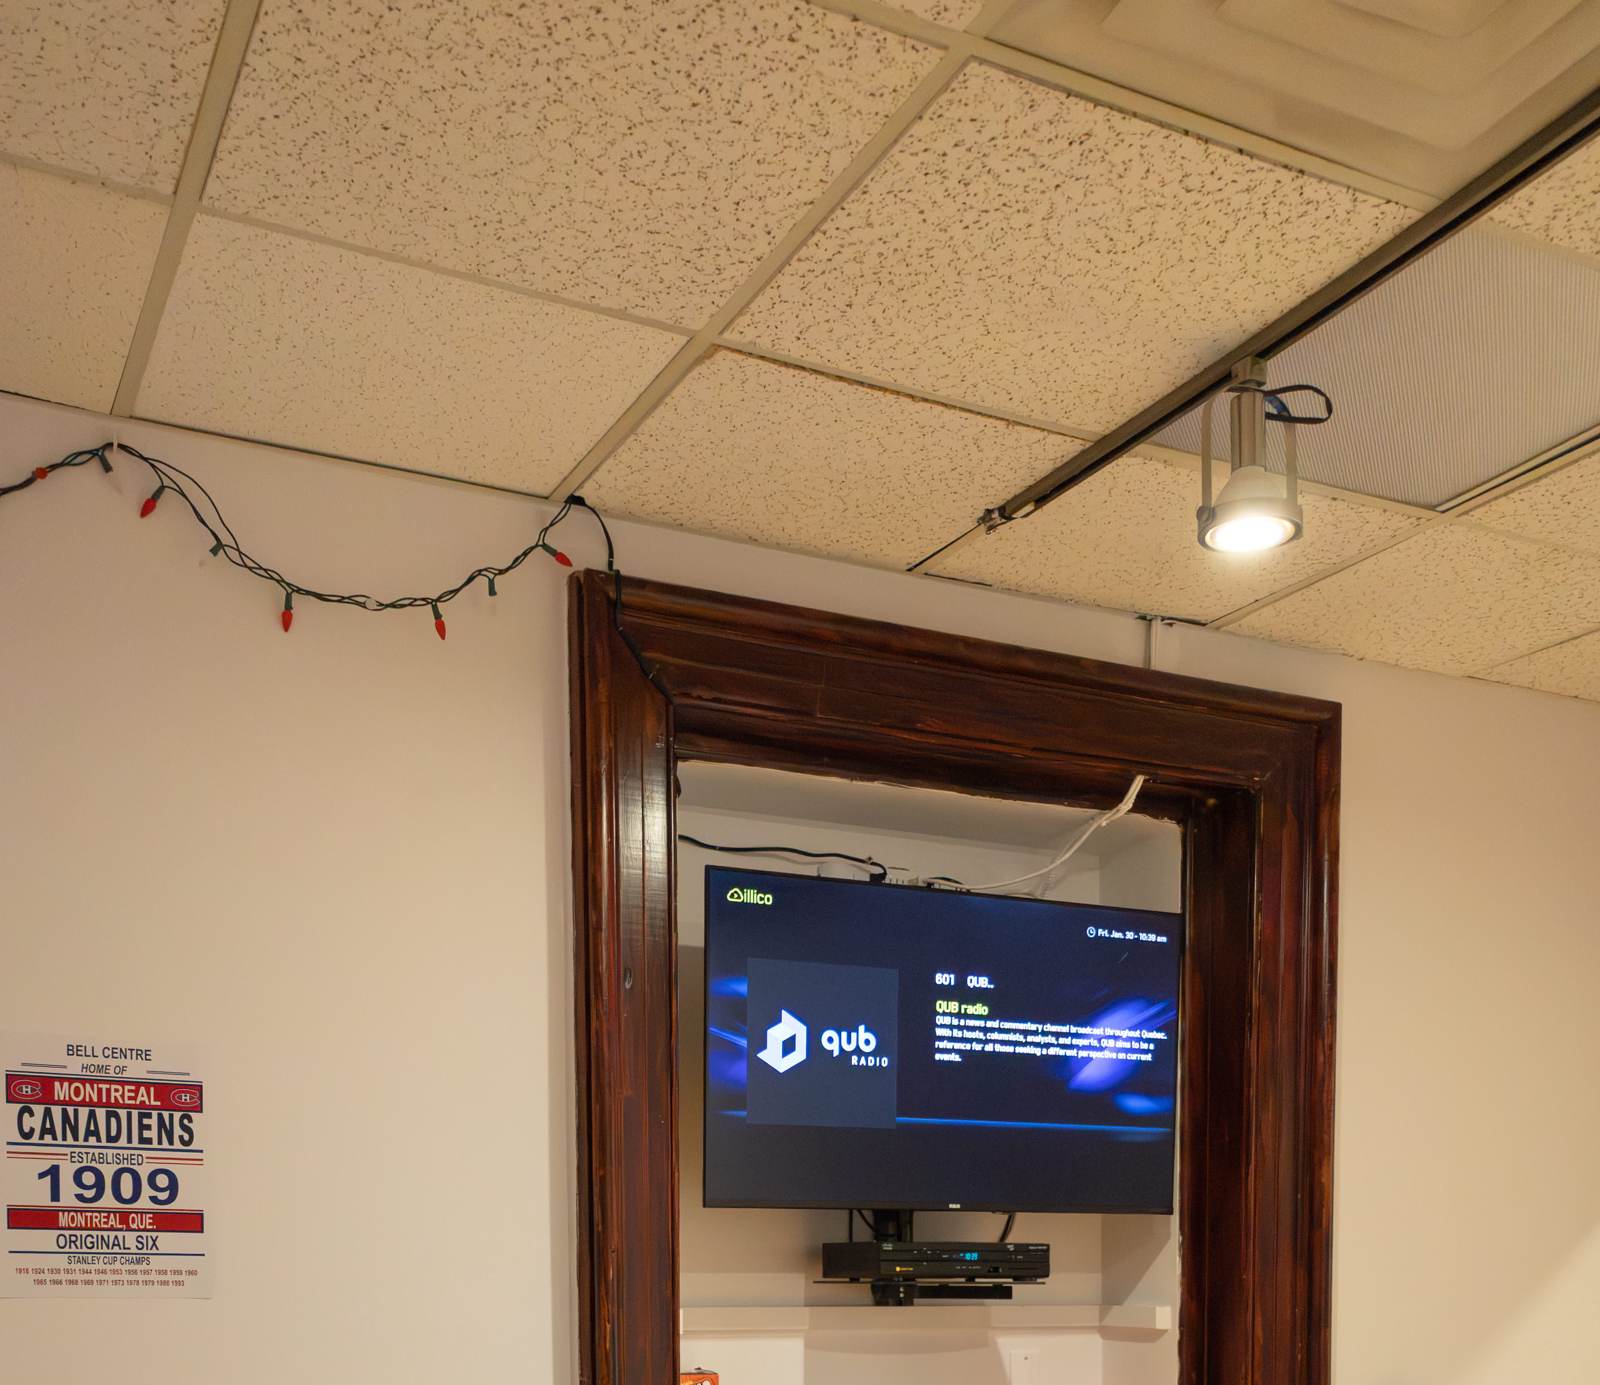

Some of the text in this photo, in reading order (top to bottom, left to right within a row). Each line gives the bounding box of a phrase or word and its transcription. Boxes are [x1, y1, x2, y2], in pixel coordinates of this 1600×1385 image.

[743, 889, 773, 905] illico
[1110, 930, 1124, 939] Jan.
[1125, 931, 1134, 940] 30
[935, 973, 955, 986] 601
[935, 1000, 989, 1015] QUB radio
[935, 1015, 951, 1026] QUB
[951, 1017, 959, 1026] is
[965, 1018, 985, 1028] news
[985, 1019, 999, 1028] and
[999, 1021, 1043, 1033] commentary
[1043, 1023, 1069, 1033] channel
[1070, 1025, 1104, 1036] broadcast
[1104, 1026, 1140, 1038] throughout
[820, 1023, 877, 1058] qub
[935, 1027, 952, 1037] With
[952, 1028, 963, 1038] its
[963, 1029, 986, 1040] hosts,
[986, 1031, 1026, 1042] columnists,
[1026, 1033, 1057, 1045] analysts,
[1058, 1036, 1071, 1045] and
[1071, 1037, 1100, 1047] experts,
[1100, 1038, 1116, 1048] QUB
[1115, 1040, 1131, 1049] aims
[1131, 1040, 1139, 1049] to
[1140, 1041, 1148, 1050] be
[66, 1044, 152, 1061] BELL CENTRE
[934, 1053, 962, 1062] events.
[935, 1039, 971, 1050] reference
[971, 1041, 984, 1051] for
[984, 1042, 993, 1052] all
[994, 1043, 1014, 1053] those
[1014, 1045, 1041, 1056] seeking
[1047, 1046, 1078, 1057] different
[1077, 1049, 1116, 1060] perspective
[1117, 1052, 1126, 1060] on
[1126, 1053, 1153, 1061] current
[81, 1063, 128, 1075] HOME OF
[851, 1055, 889, 1068] RADIO
[54, 1081, 161, 1106] MONTREAL
[16, 1105, 195, 1147] CANADIENS
[69, 1151, 144, 1166] ESTABLISHED
[37, 1164, 180, 1206] 1909
[58, 1211, 157, 1231] MONTREAL, QUE.
[55, 1233, 159, 1251] ORIGINAL SIX
[67, 1255, 151, 1266] STANLEY CUP CHAMPS
